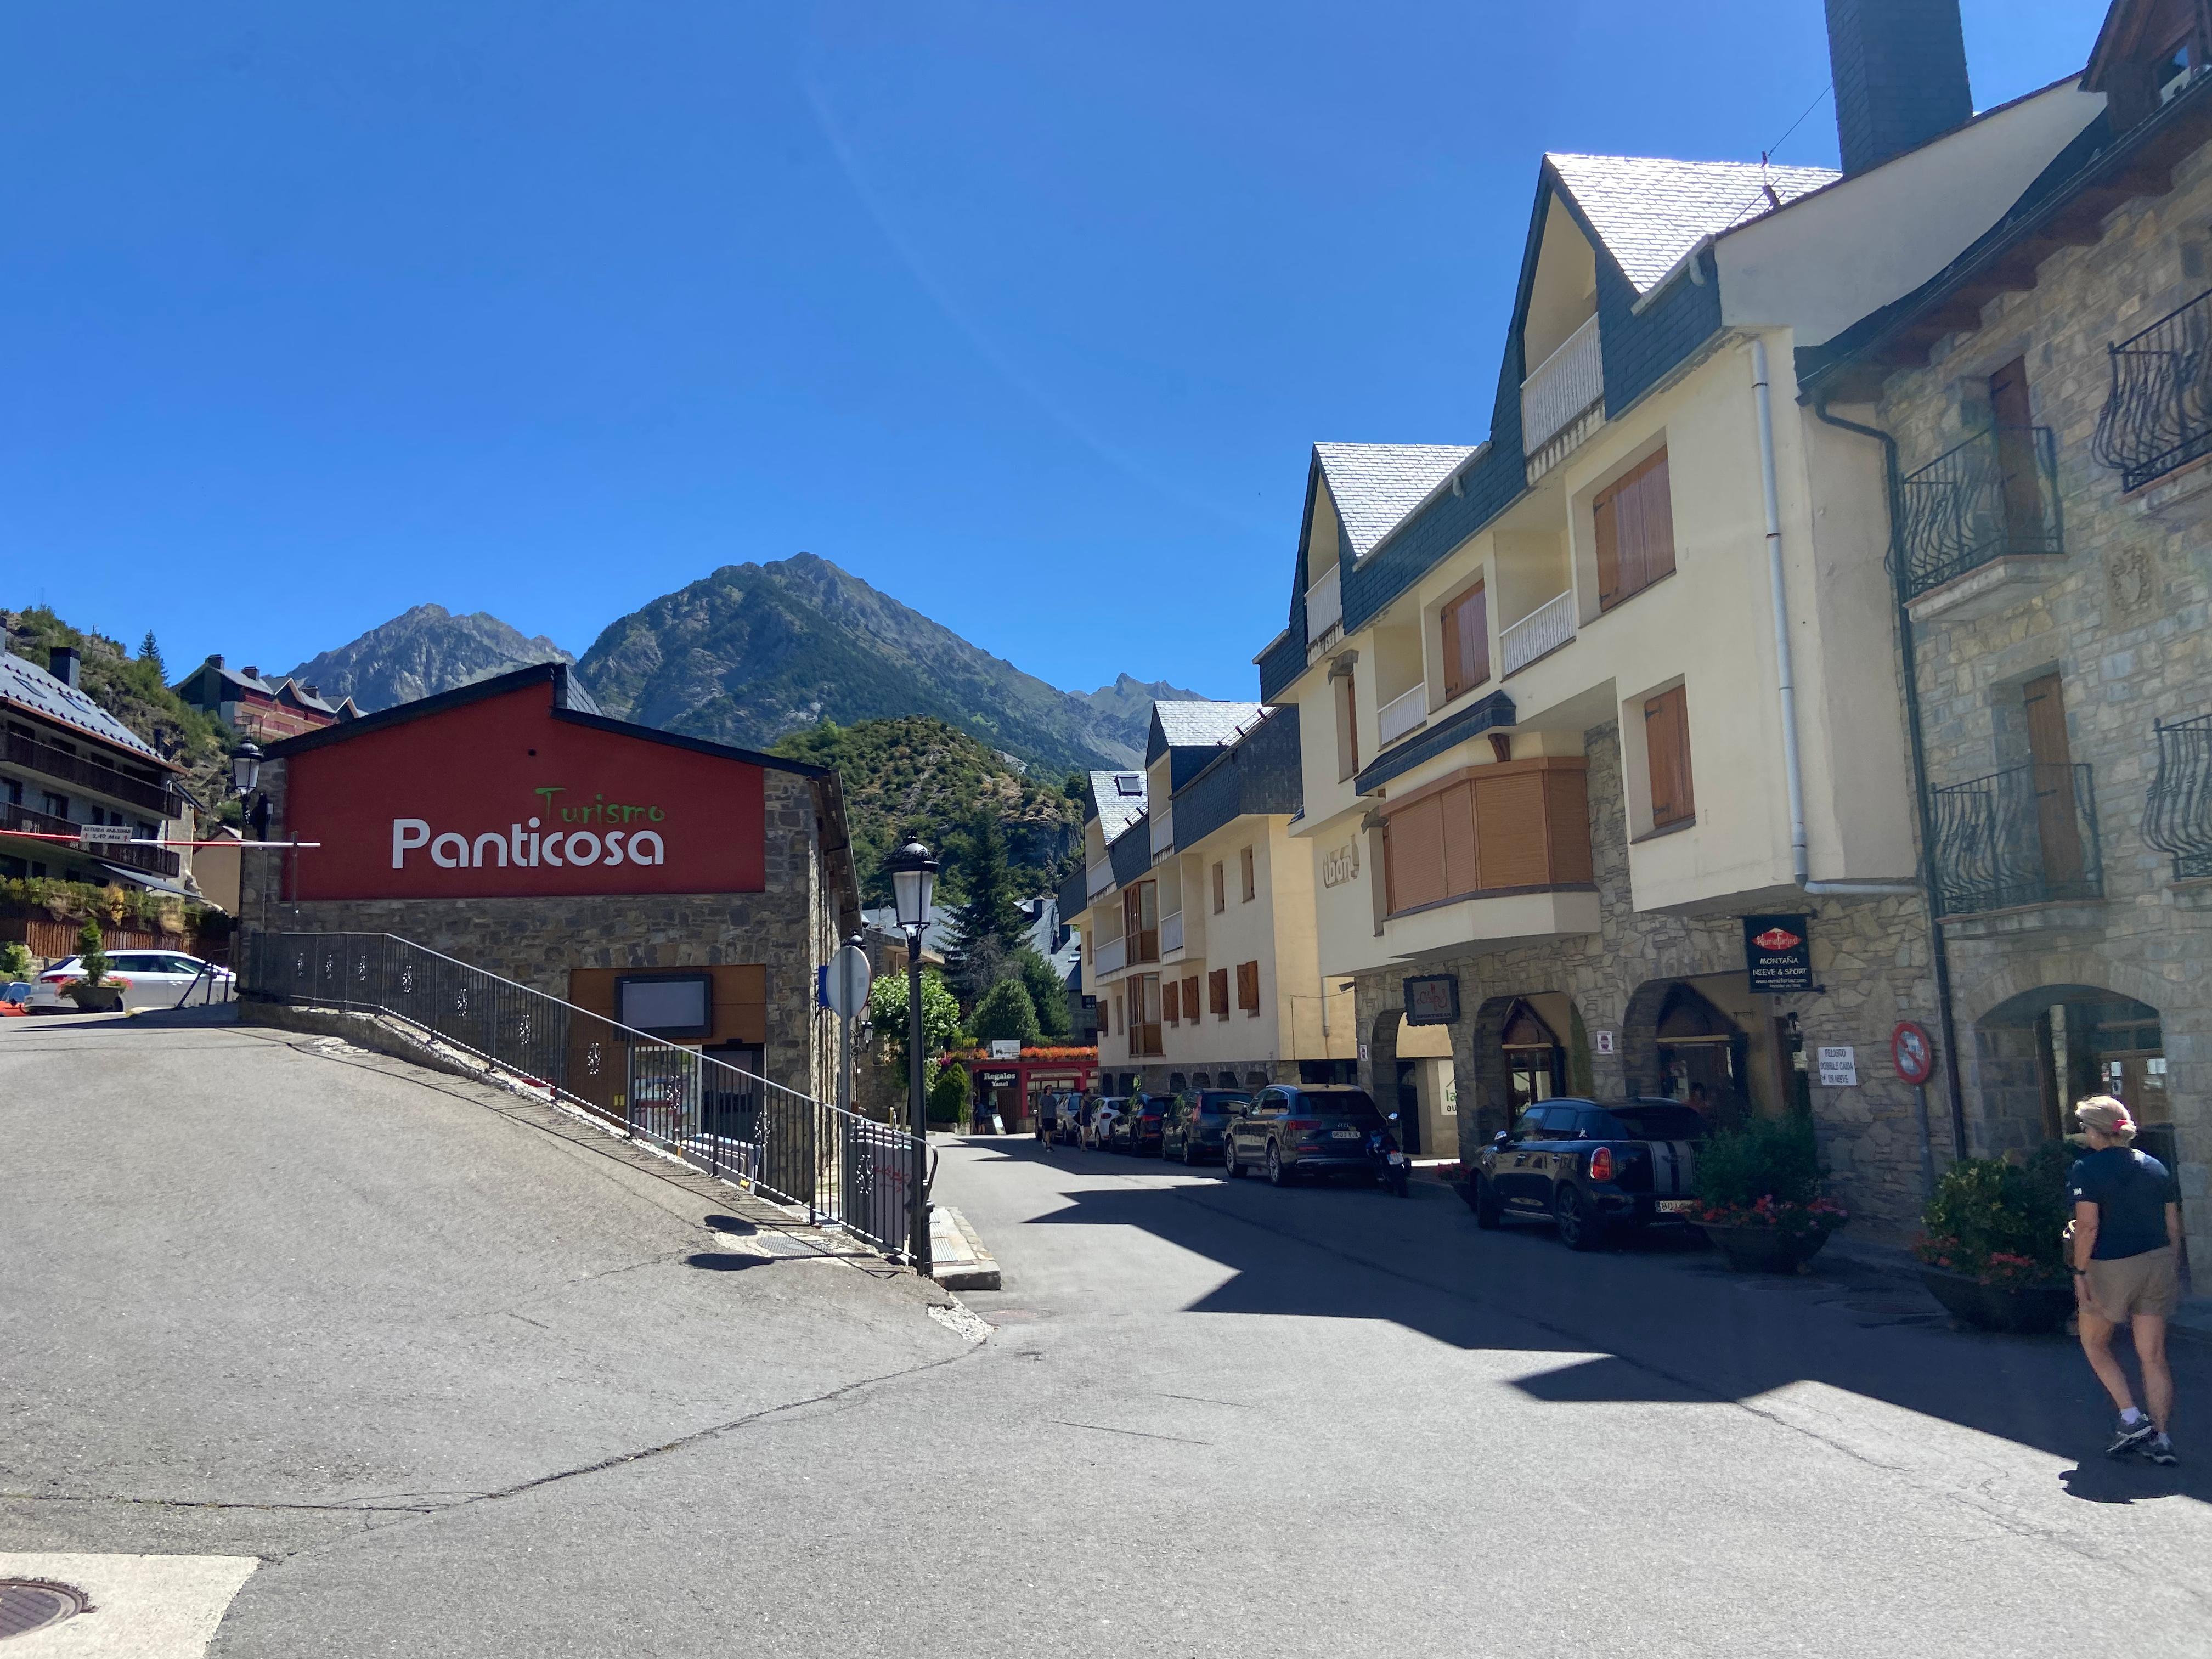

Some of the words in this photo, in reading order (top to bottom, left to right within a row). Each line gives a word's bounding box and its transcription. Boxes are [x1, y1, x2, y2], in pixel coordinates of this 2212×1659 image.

[535, 787, 665, 824] Turismo
[392, 817, 664, 869] Panticosa
[1760, 956, 1798, 964] MONTAÑA
[1825, 1048, 1846, 1057] PELIGRO
[984, 1073, 1016, 1081] Regalos
